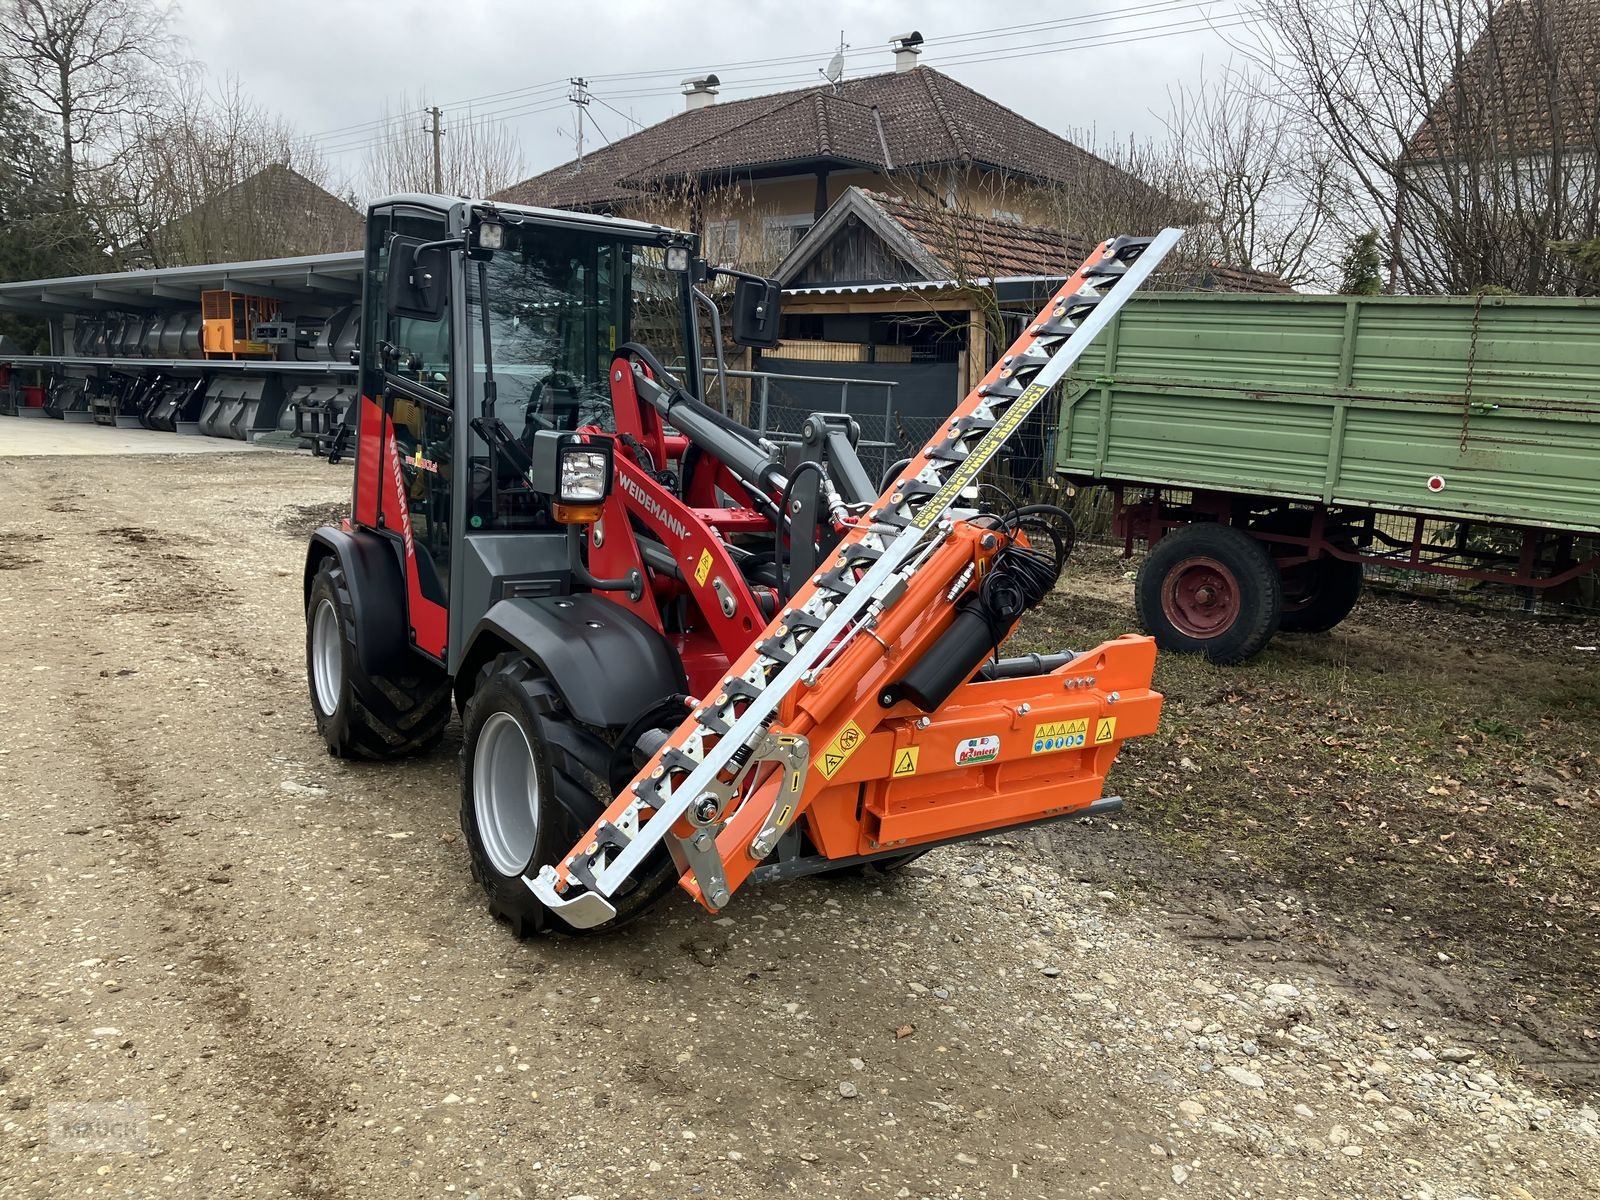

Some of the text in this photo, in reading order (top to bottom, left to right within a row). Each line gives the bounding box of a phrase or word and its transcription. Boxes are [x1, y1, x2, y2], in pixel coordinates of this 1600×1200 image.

[389, 433, 414, 558] WEIDEMANN
[619, 470, 686, 540] WEIDEMANN
[918, 386, 1047, 528] TOGLIERE PRIMA DELL'USO
[913, 497, 939, 525] MACHINE
